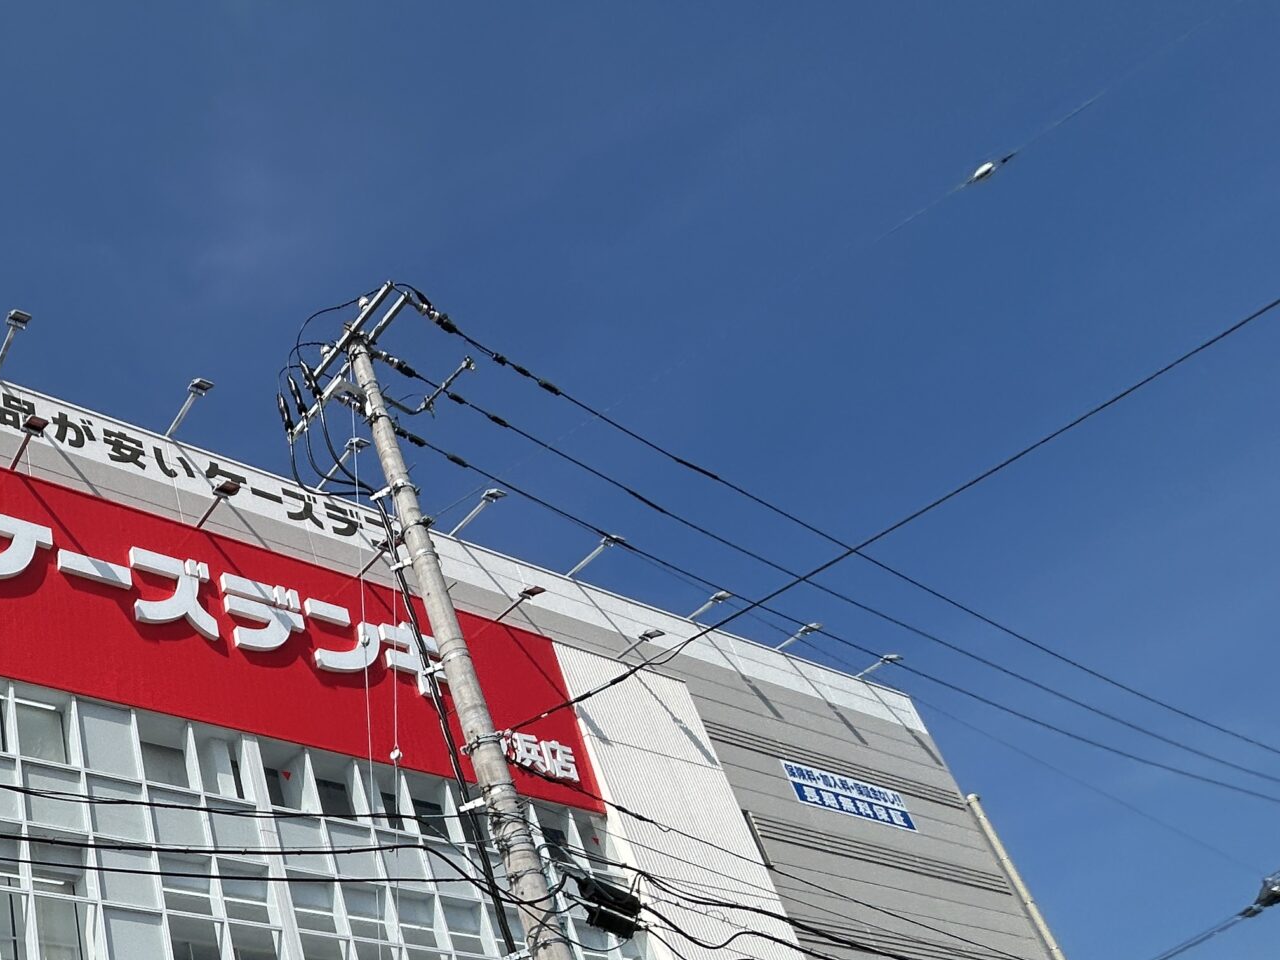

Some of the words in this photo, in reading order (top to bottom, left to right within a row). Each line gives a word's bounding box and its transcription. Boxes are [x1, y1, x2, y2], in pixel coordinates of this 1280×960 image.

[500, 731, 580, 782] 浜店
[803, 785, 908, 827] 長期無料保証
